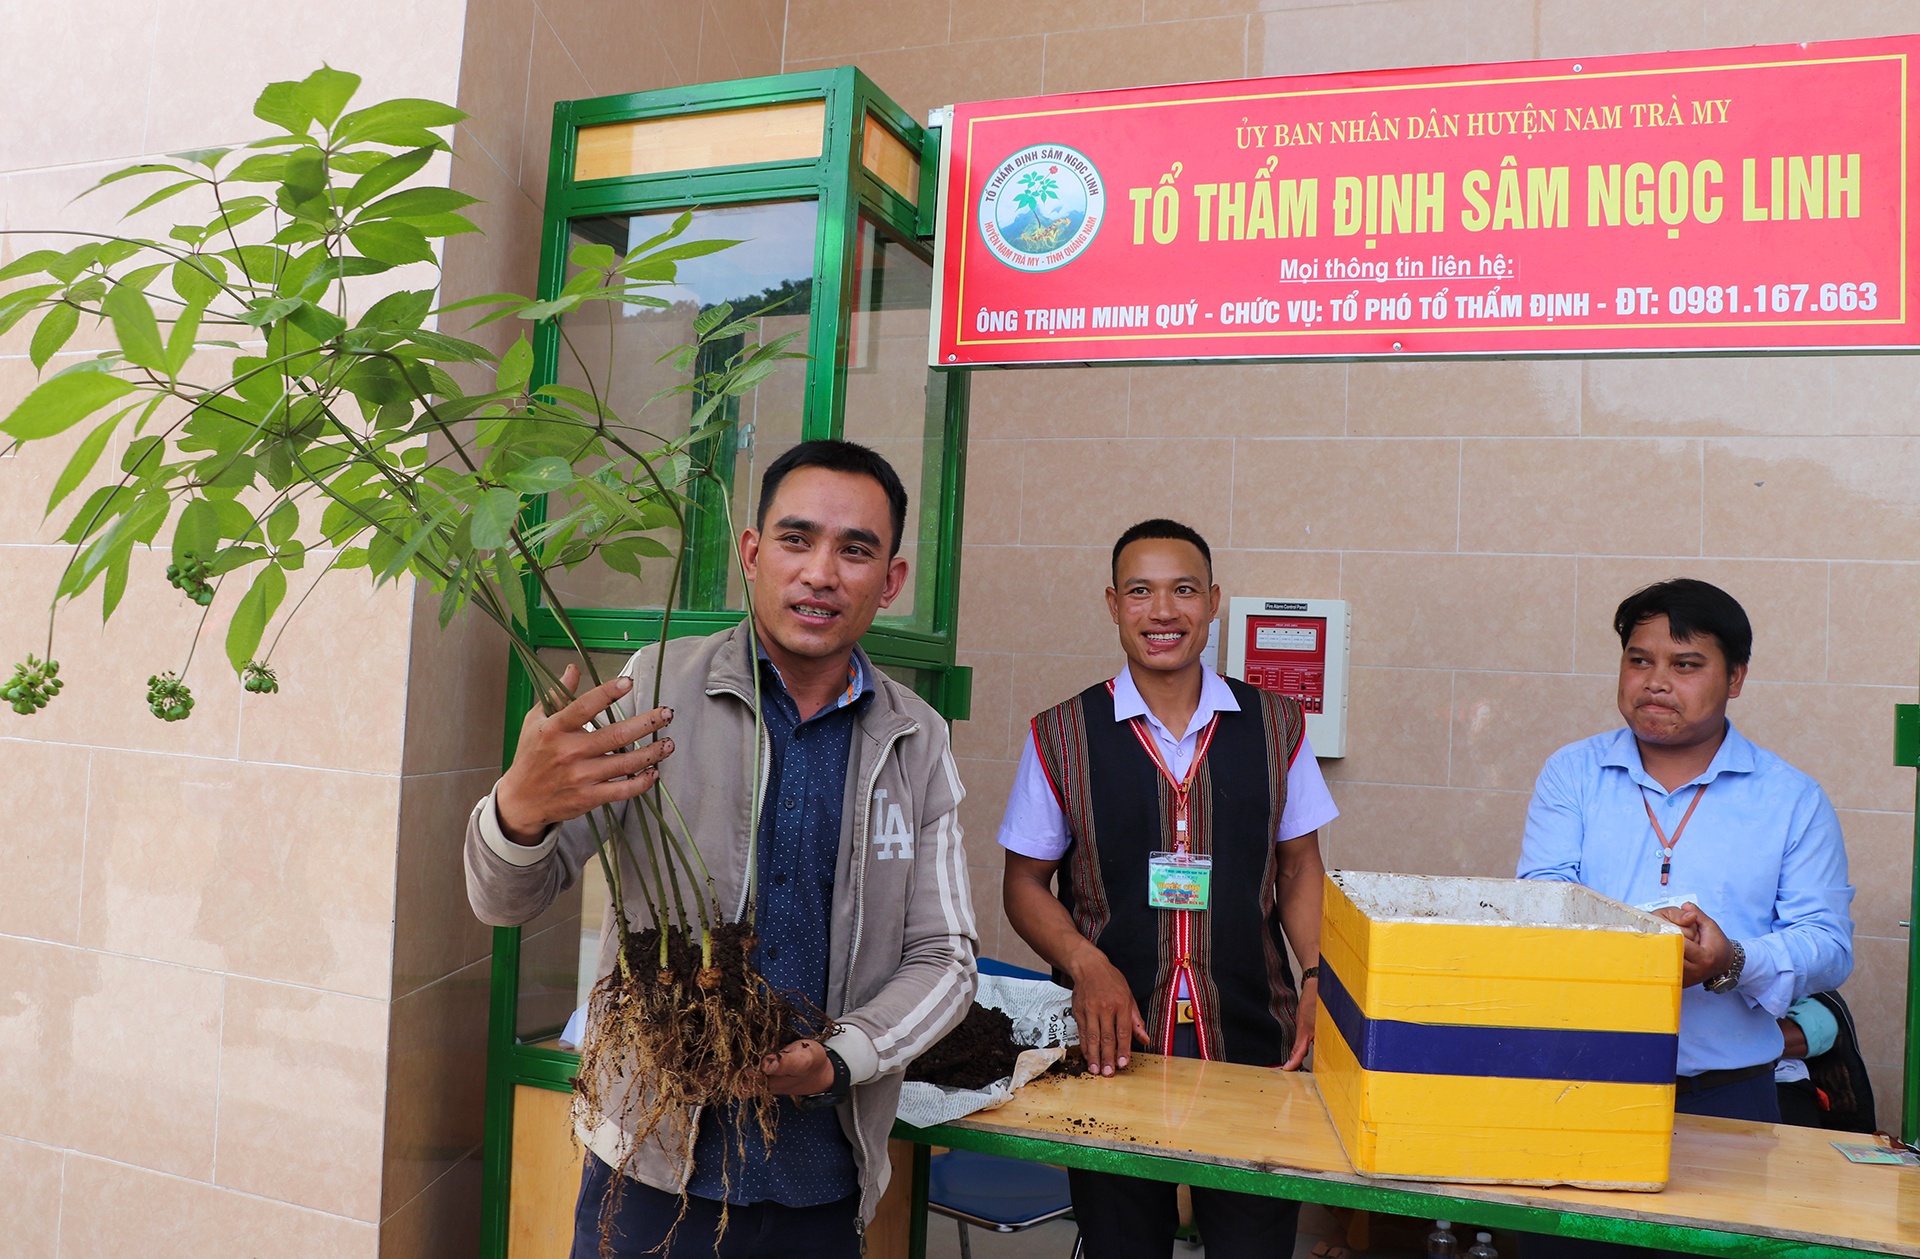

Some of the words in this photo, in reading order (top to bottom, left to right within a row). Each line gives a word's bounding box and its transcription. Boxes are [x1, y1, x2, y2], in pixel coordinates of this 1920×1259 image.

[1235, 116, 1268, 149] ỦY
[1274, 122, 1324, 147] BAN
[1330, 111, 1400, 144] NHÂN
[1407, 108, 1460, 140] DÂN
[1467, 103, 1556, 140] HUYỆN
[1564, 105, 1623, 132] NAM
[1630, 95, 1684, 126] TRÀ
[1691, 99, 1732, 124] MY
[985, 188, 997, 202] TỔ
[991, 166, 1014, 188] THẨM
[1014, 150, 1038, 168] ĐỊNH
[1041, 147, 1063, 160] SÂM
[1064, 153, 1088, 175] NGỌC
[1083, 172, 1099, 196] LINH
[1129, 161, 1184, 245] TỔ
[1194, 155, 1318, 242] THẨM
[1333, 172, 1445, 249] ĐỊNH
[1461, 155, 1569, 232] SÂM
[1588, 160, 1724, 239] NGỌC
[1742, 154, 1861, 222] LINH
[984, 221, 1000, 247] HUYỆN
[996, 241, 1014, 260] NAM
[1013, 253, 1027, 266] TRÀ
[1027, 257, 1040, 267] MY
[1082, 215, 1097, 237] NAM
[1280, 258, 1319, 284] Mọi
[1325, 257, 1389, 283] thông
[1396, 256, 1424, 277] tin
[1431, 254, 1471, 277] liên
[1479, 253, 1513, 280] hệ:
[976, 307, 1019, 333] ÔNG
[1024, 307, 1086, 335] TRỊNH
[1091, 305, 1149, 329] MINH
[1156, 299, 1199, 329] QUÝ
[1220, 297, 1281, 325] CHỨC
[1287, 300, 1323, 328] VỤ:
[1330, 290, 1360, 322] TỔ
[1364, 293, 1412, 321] PHÓ
[1419, 287, 1450, 321] TỔ
[1454, 286, 1522, 318] THẨM
[1529, 292, 1590, 323] ĐỊNH
[1615, 286, 1659, 316] ĐT:
[1668, 282, 1878, 315] 0981.167.663
[872, 788, 915, 860] LA
